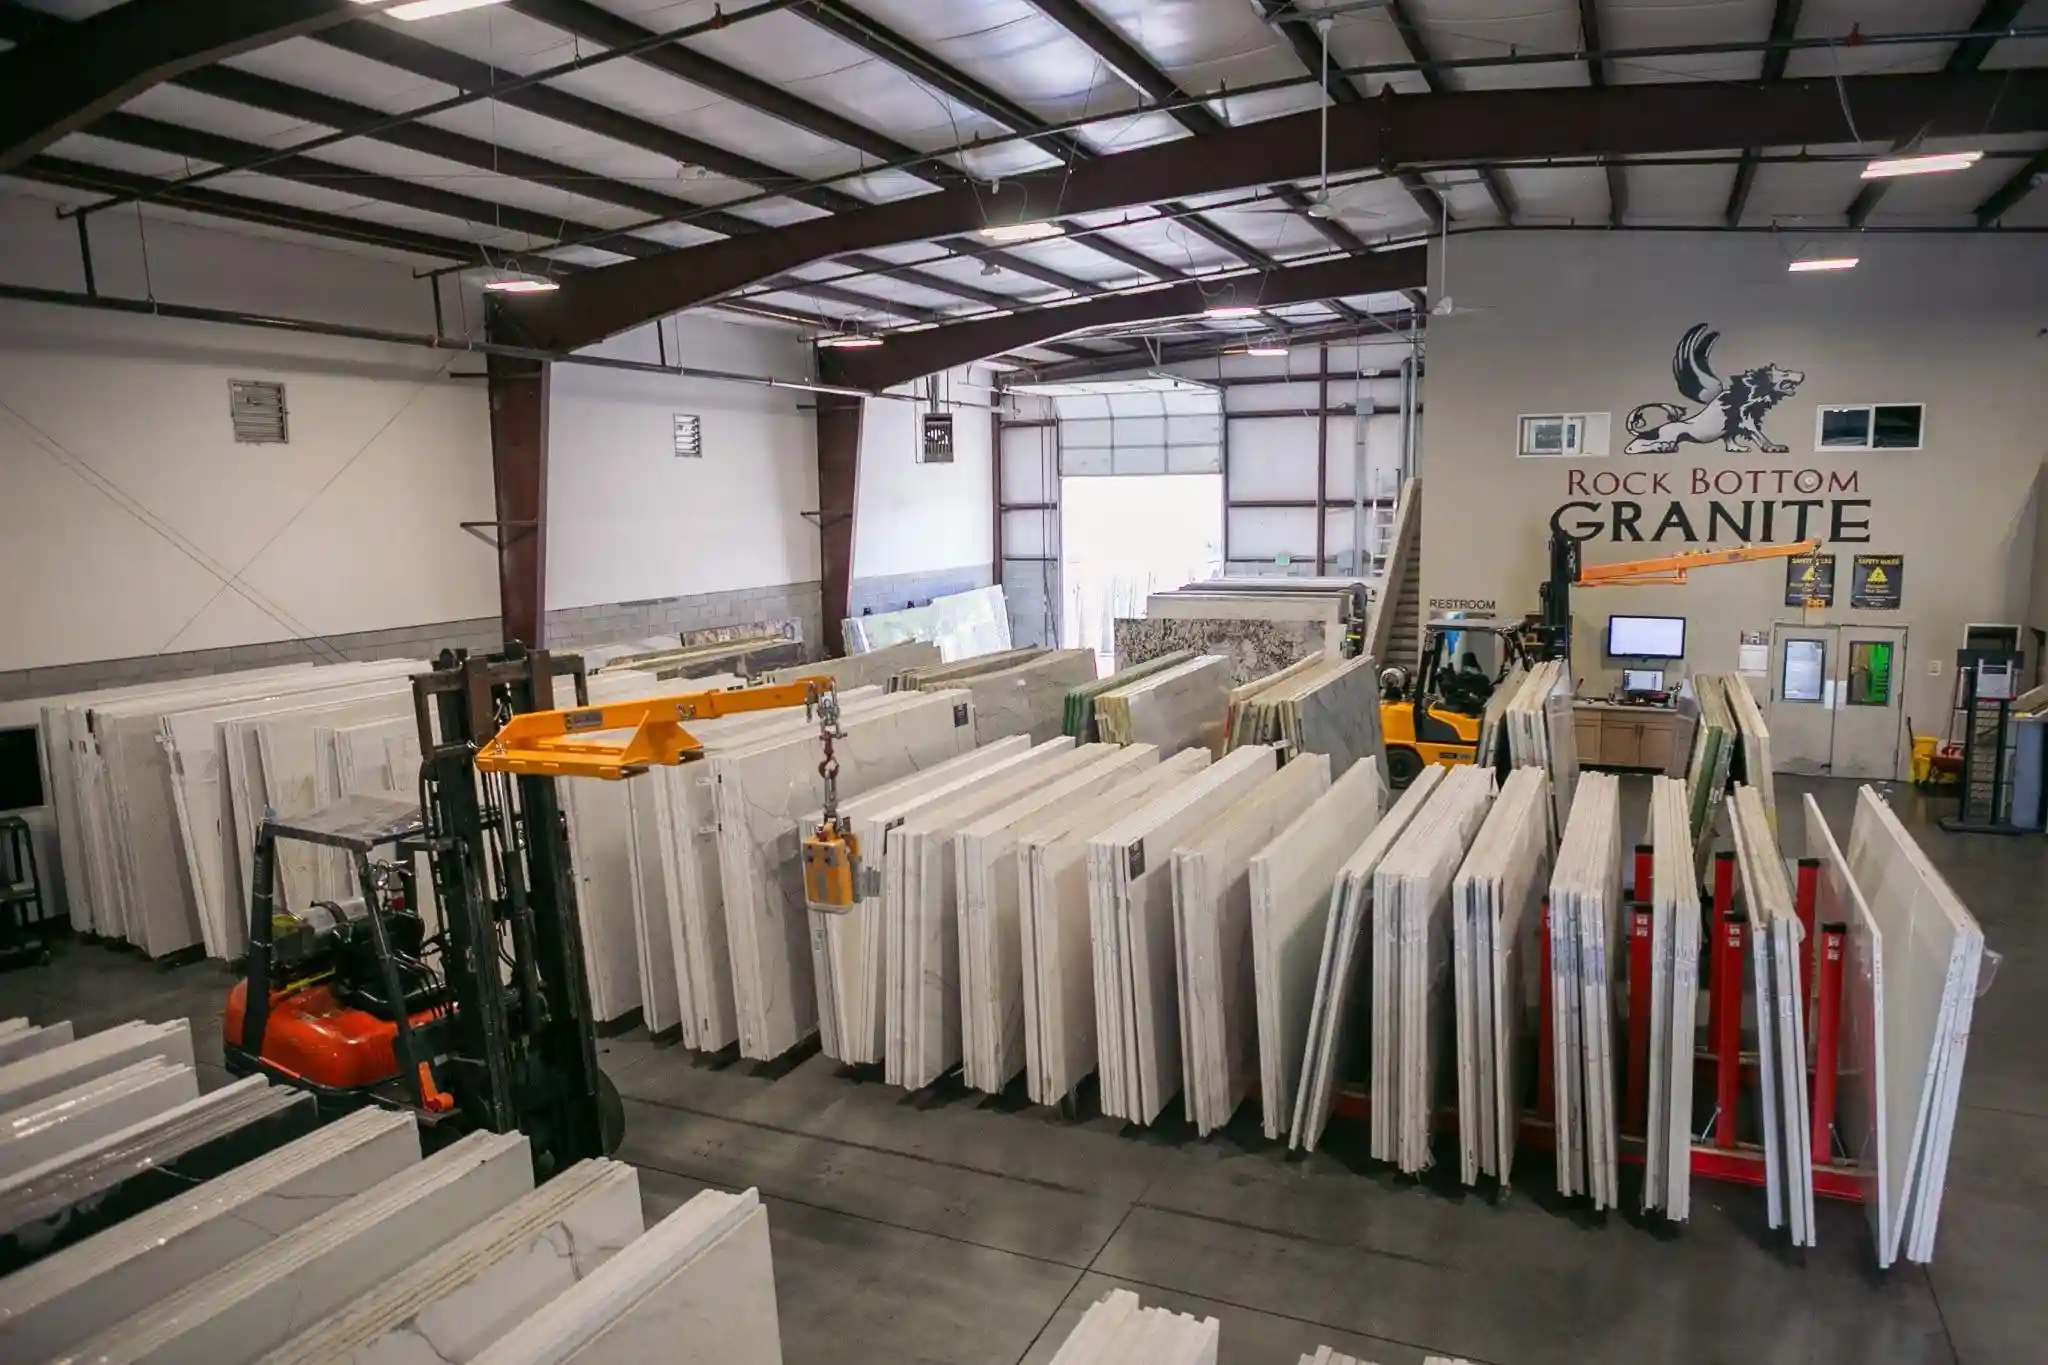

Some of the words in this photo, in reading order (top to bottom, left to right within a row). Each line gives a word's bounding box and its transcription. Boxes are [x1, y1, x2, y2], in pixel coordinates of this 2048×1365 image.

[1568, 469, 1672, 496] ROCK
[1691, 467, 1860, 495] BOTTOM
[1550, 499, 1872, 543] GRANITE
[1429, 599, 1496, 609] RESTROOM
